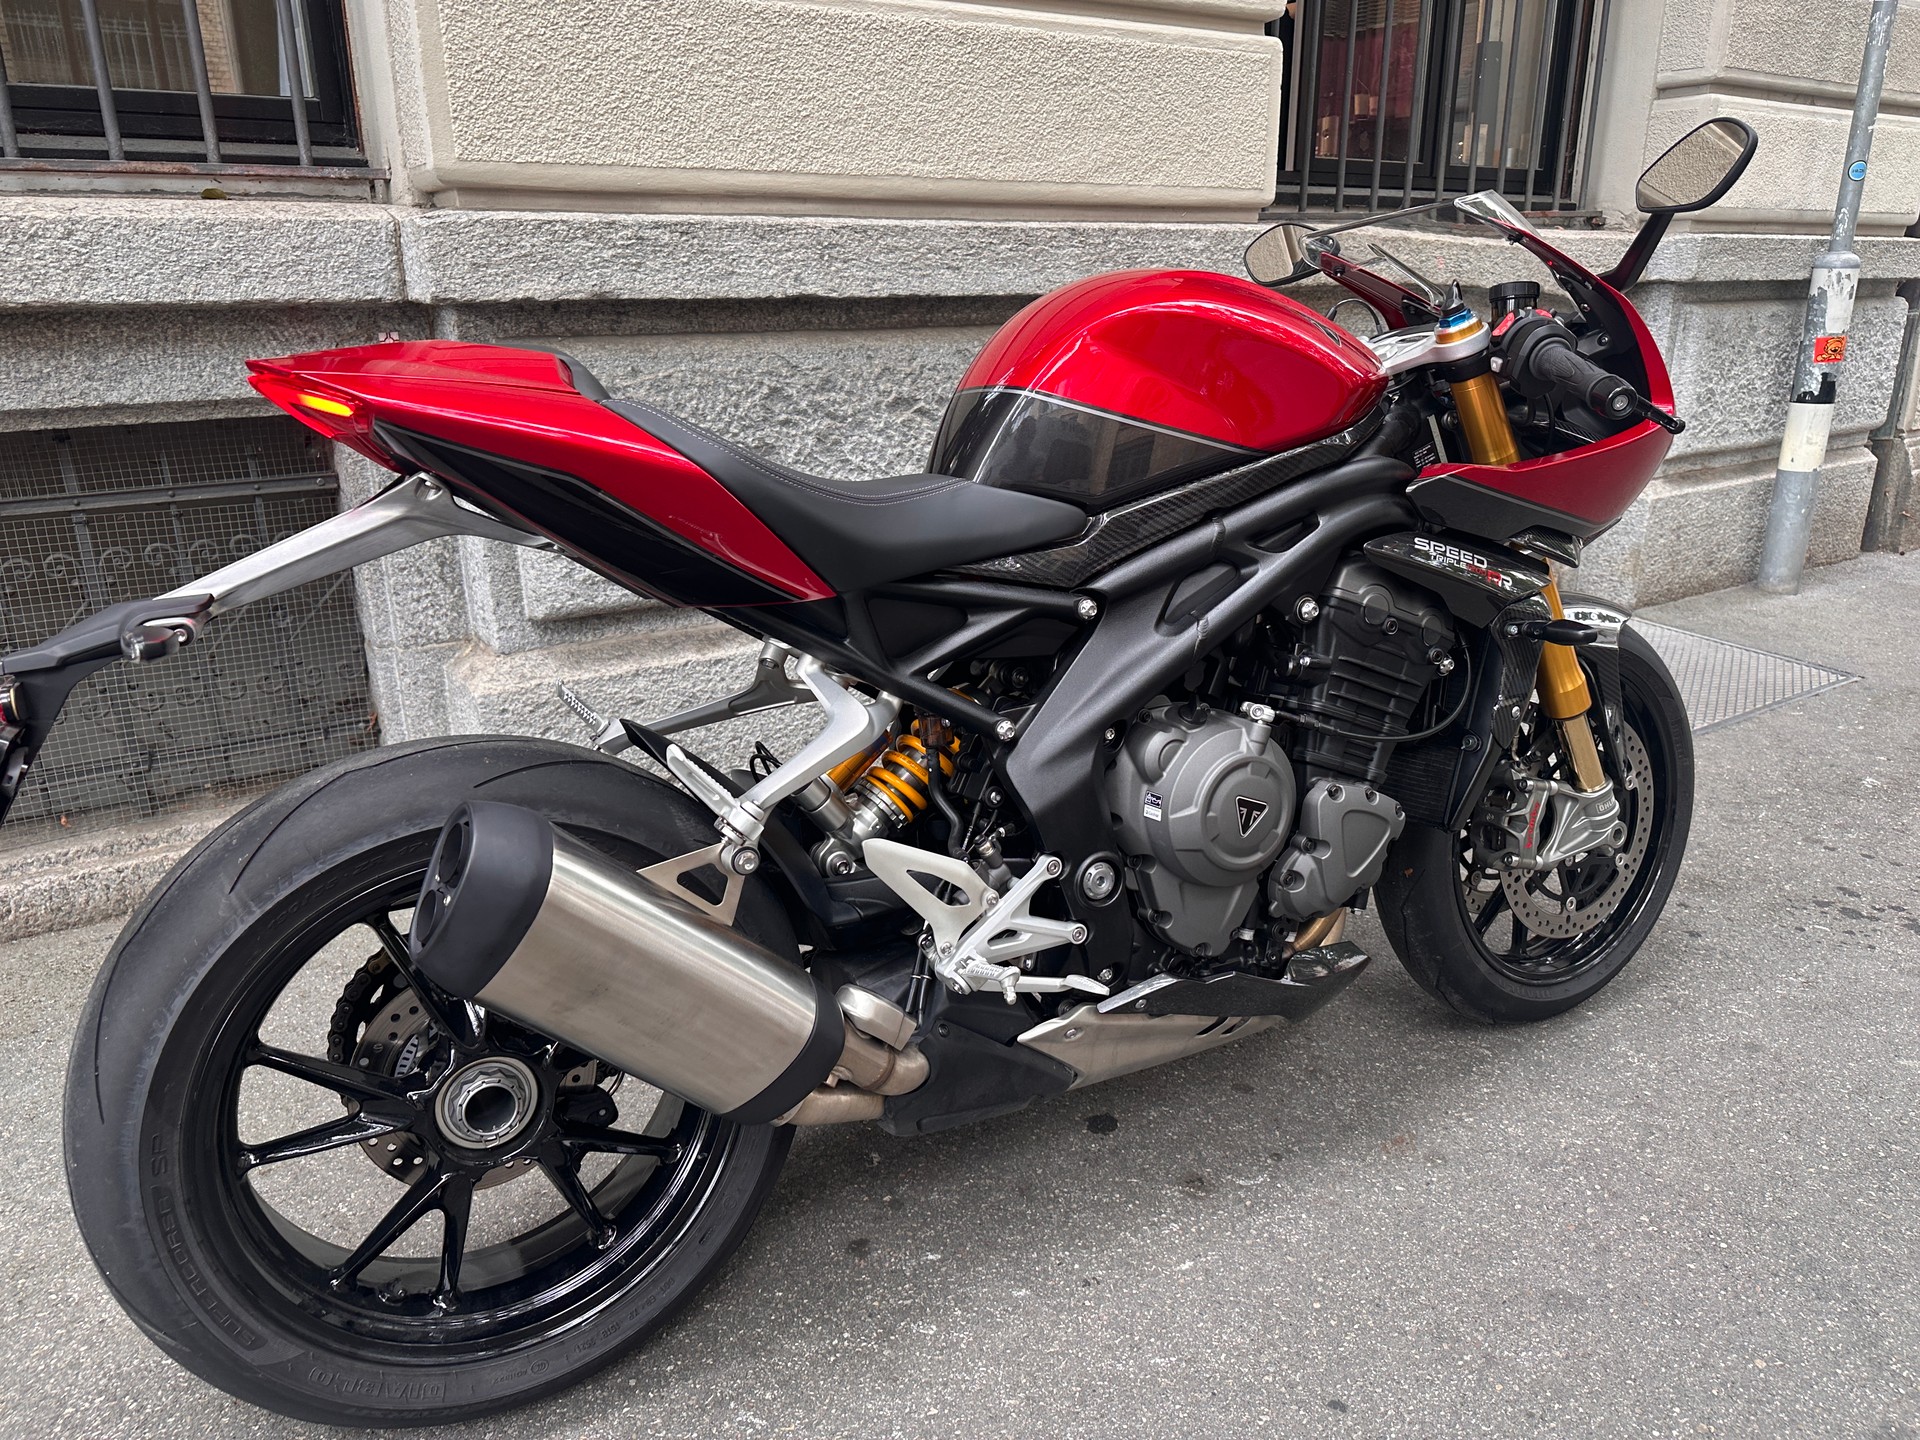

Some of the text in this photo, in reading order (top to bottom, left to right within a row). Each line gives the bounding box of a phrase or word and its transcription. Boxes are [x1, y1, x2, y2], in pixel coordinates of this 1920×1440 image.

[1414, 537, 1488, 569] SPEED
[1430, 553, 1467, 570] TRIPLE
[1524, 801, 1541, 849] brembo
[150, 1132, 169, 1177] SP
